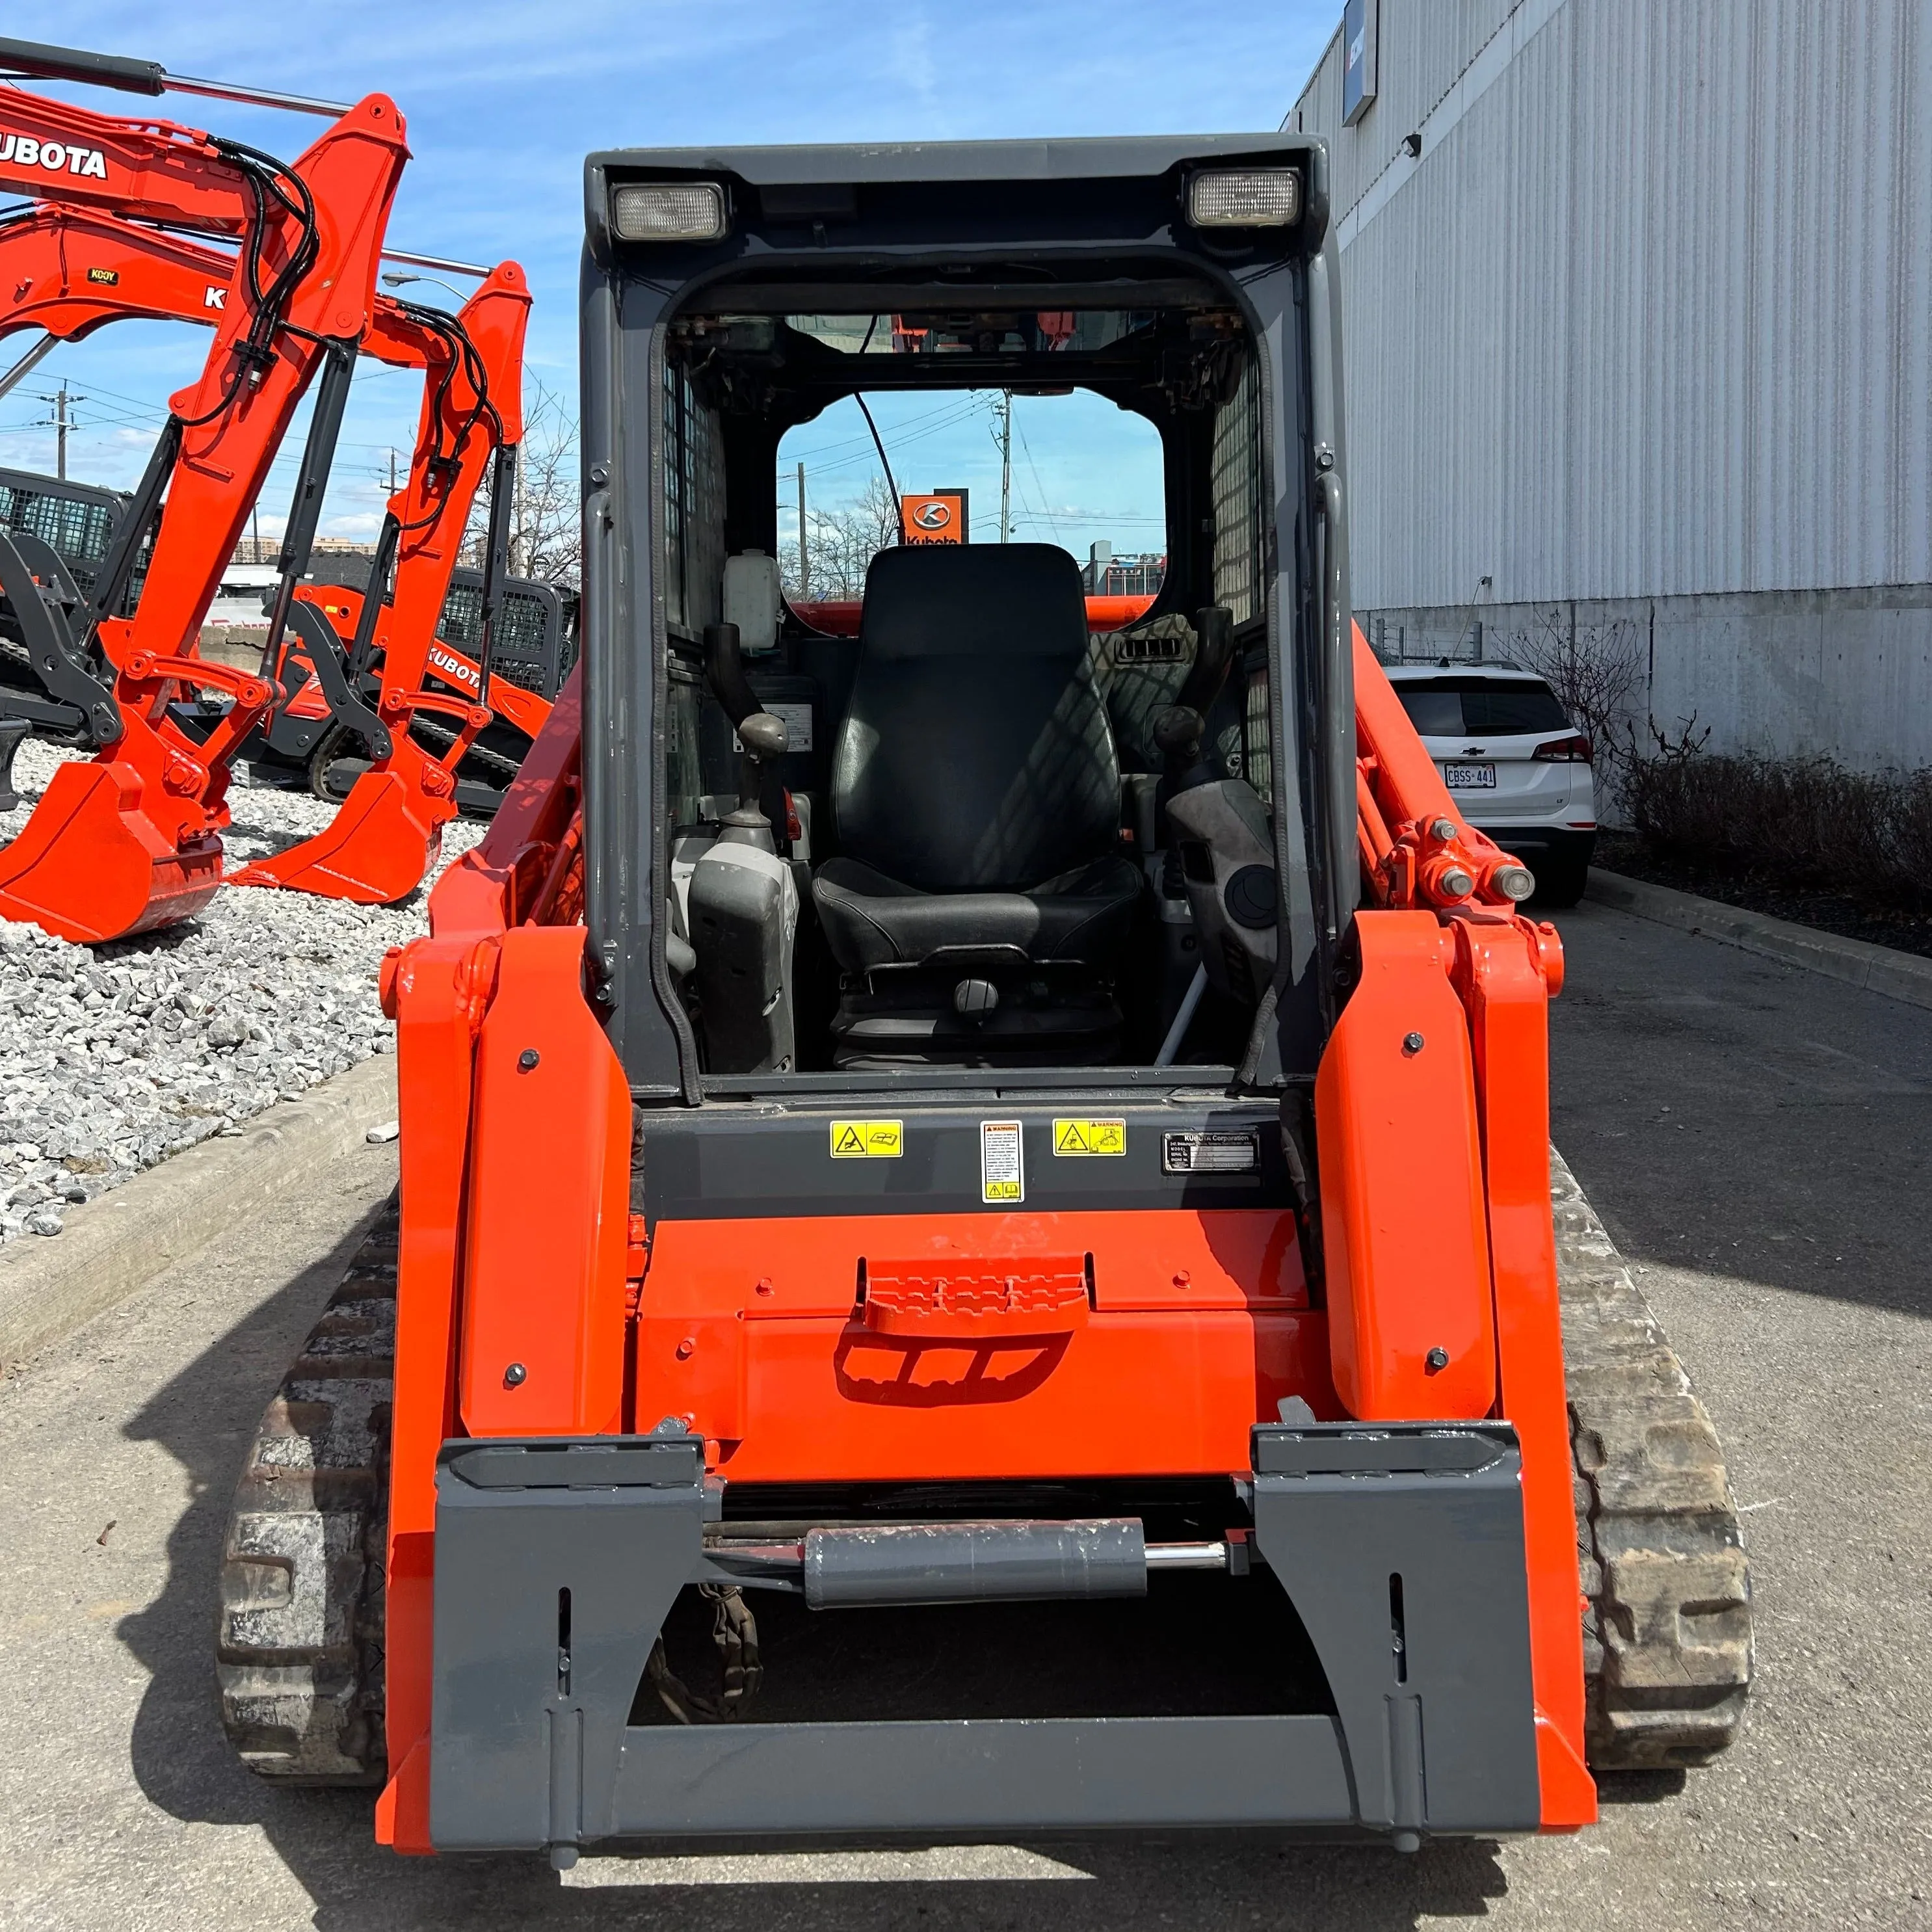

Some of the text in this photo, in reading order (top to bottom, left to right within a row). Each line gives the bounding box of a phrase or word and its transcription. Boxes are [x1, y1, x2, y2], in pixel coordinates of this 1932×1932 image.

[92, 269, 115, 281] KOOY
[1448, 771, 1493, 782] CBSS 441
